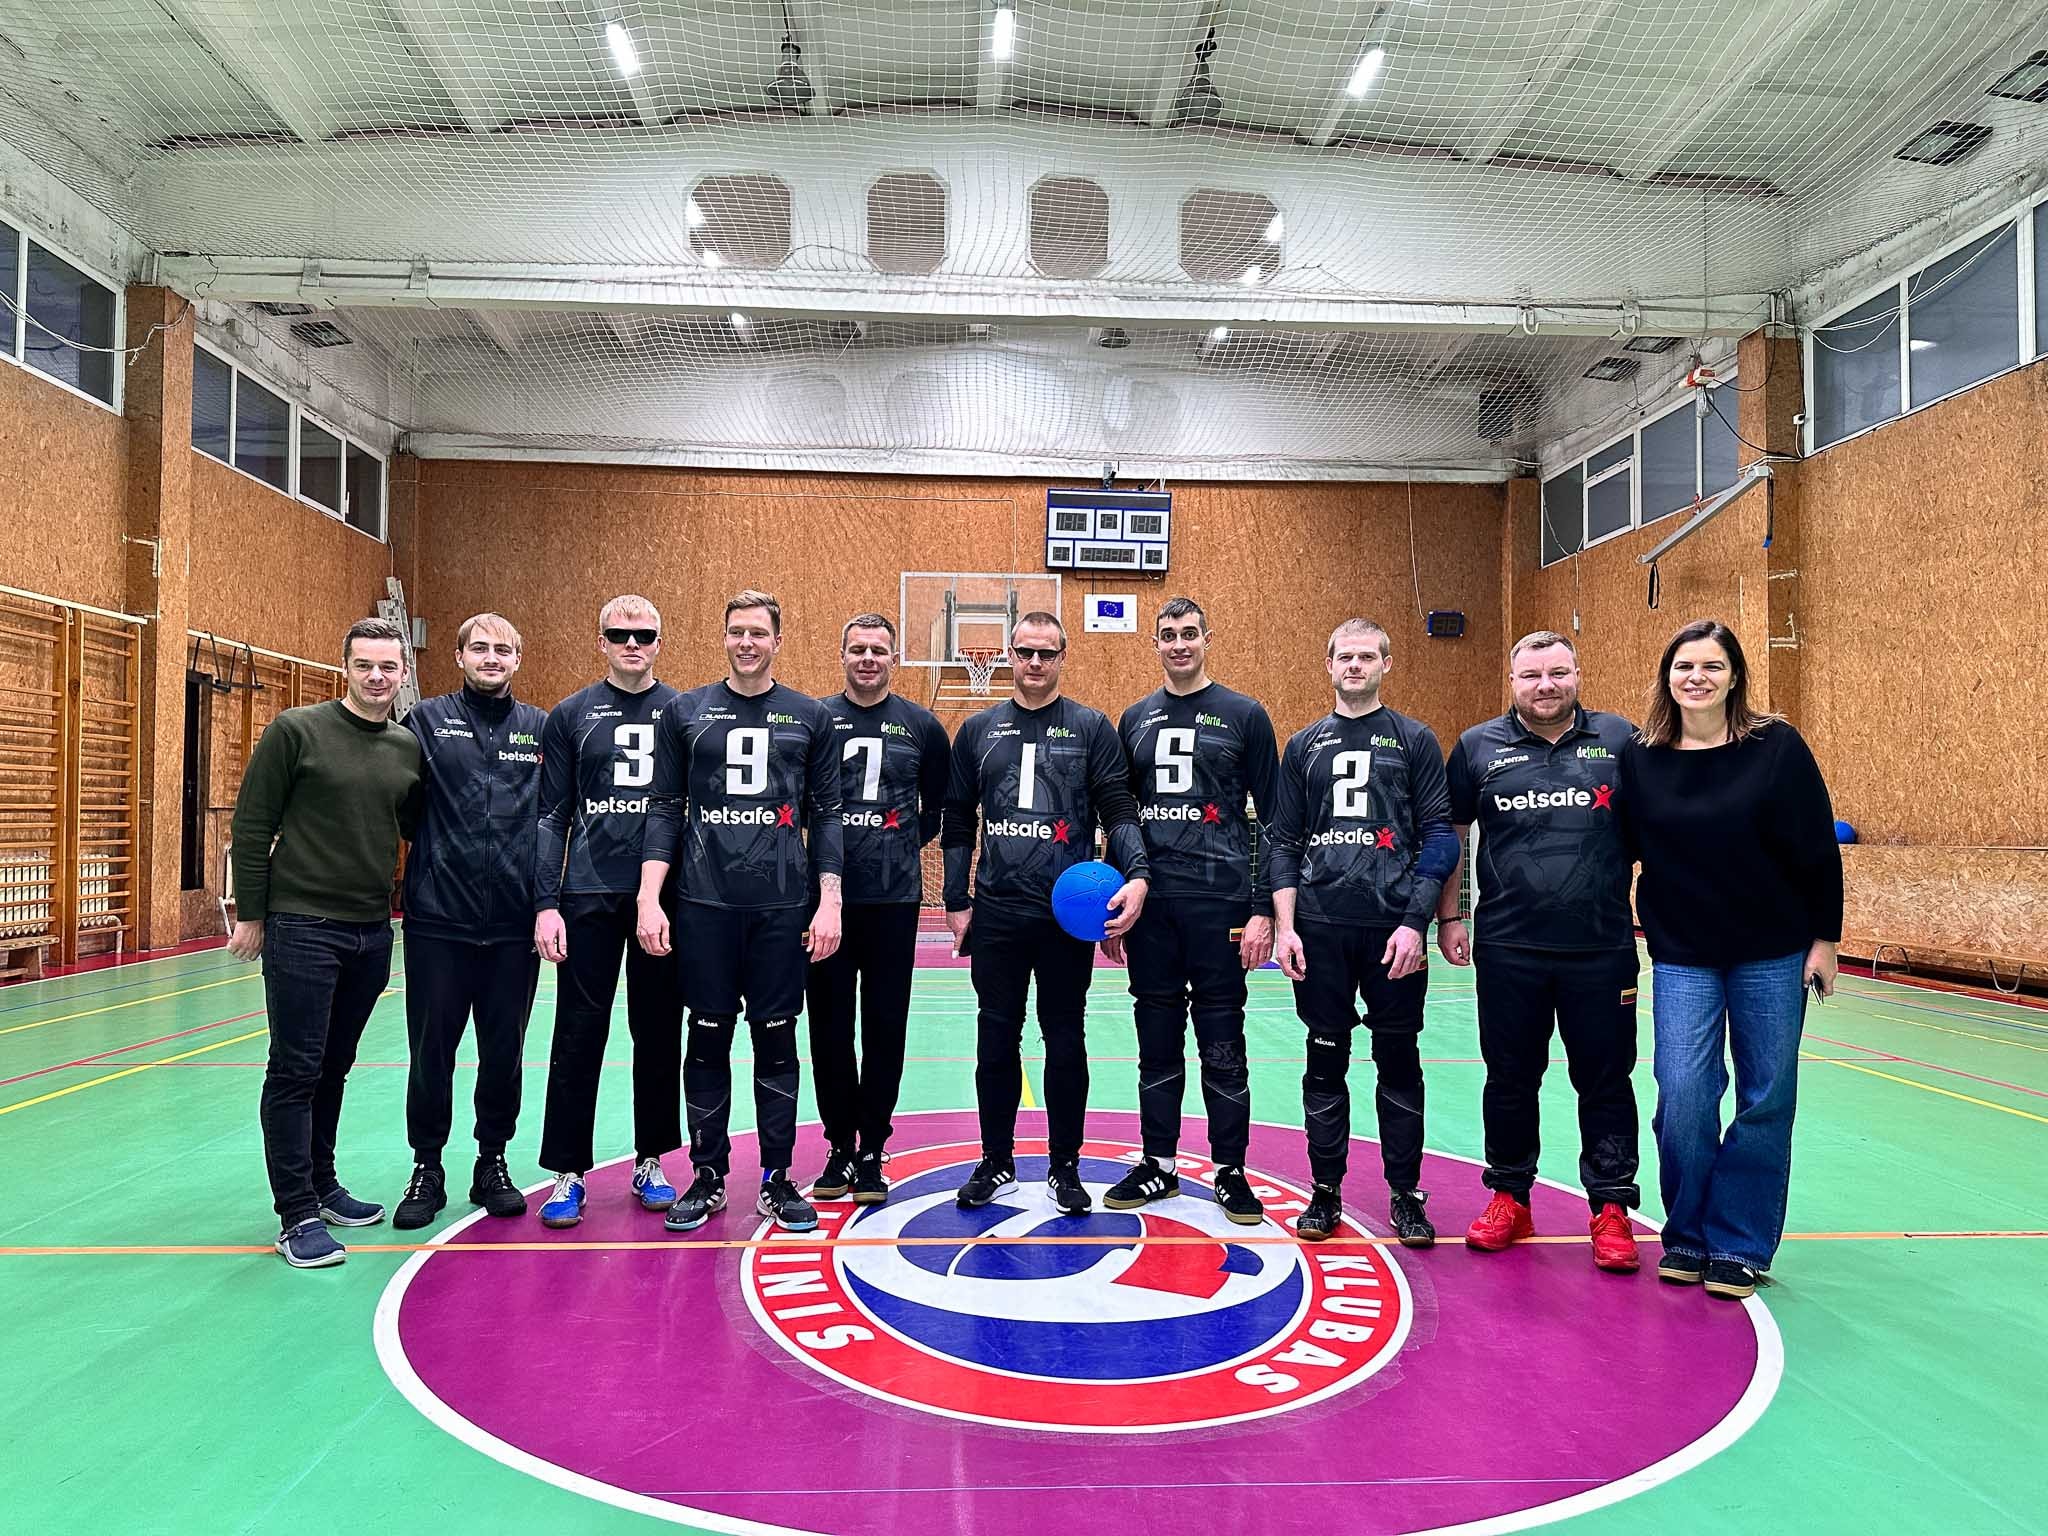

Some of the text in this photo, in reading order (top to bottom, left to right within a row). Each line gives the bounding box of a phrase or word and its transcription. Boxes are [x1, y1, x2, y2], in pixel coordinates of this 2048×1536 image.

[613, 723, 654, 787] 3
[726, 727, 769, 796] 9
[842, 736, 883, 801] 7
[1017, 742, 1036, 809] 1
[1154, 727, 1196, 794] 5
[1331, 750, 1372, 818] 2
[586, 796, 650, 815] betsaf
[700, 806, 776, 826] betsafe
[841, 810, 883, 827] safe
[986, 819, 1052, 840] betsafe
[1493, 786, 1592, 812] betsafe
[1233, 1254, 1383, 1394] KLUBAS
